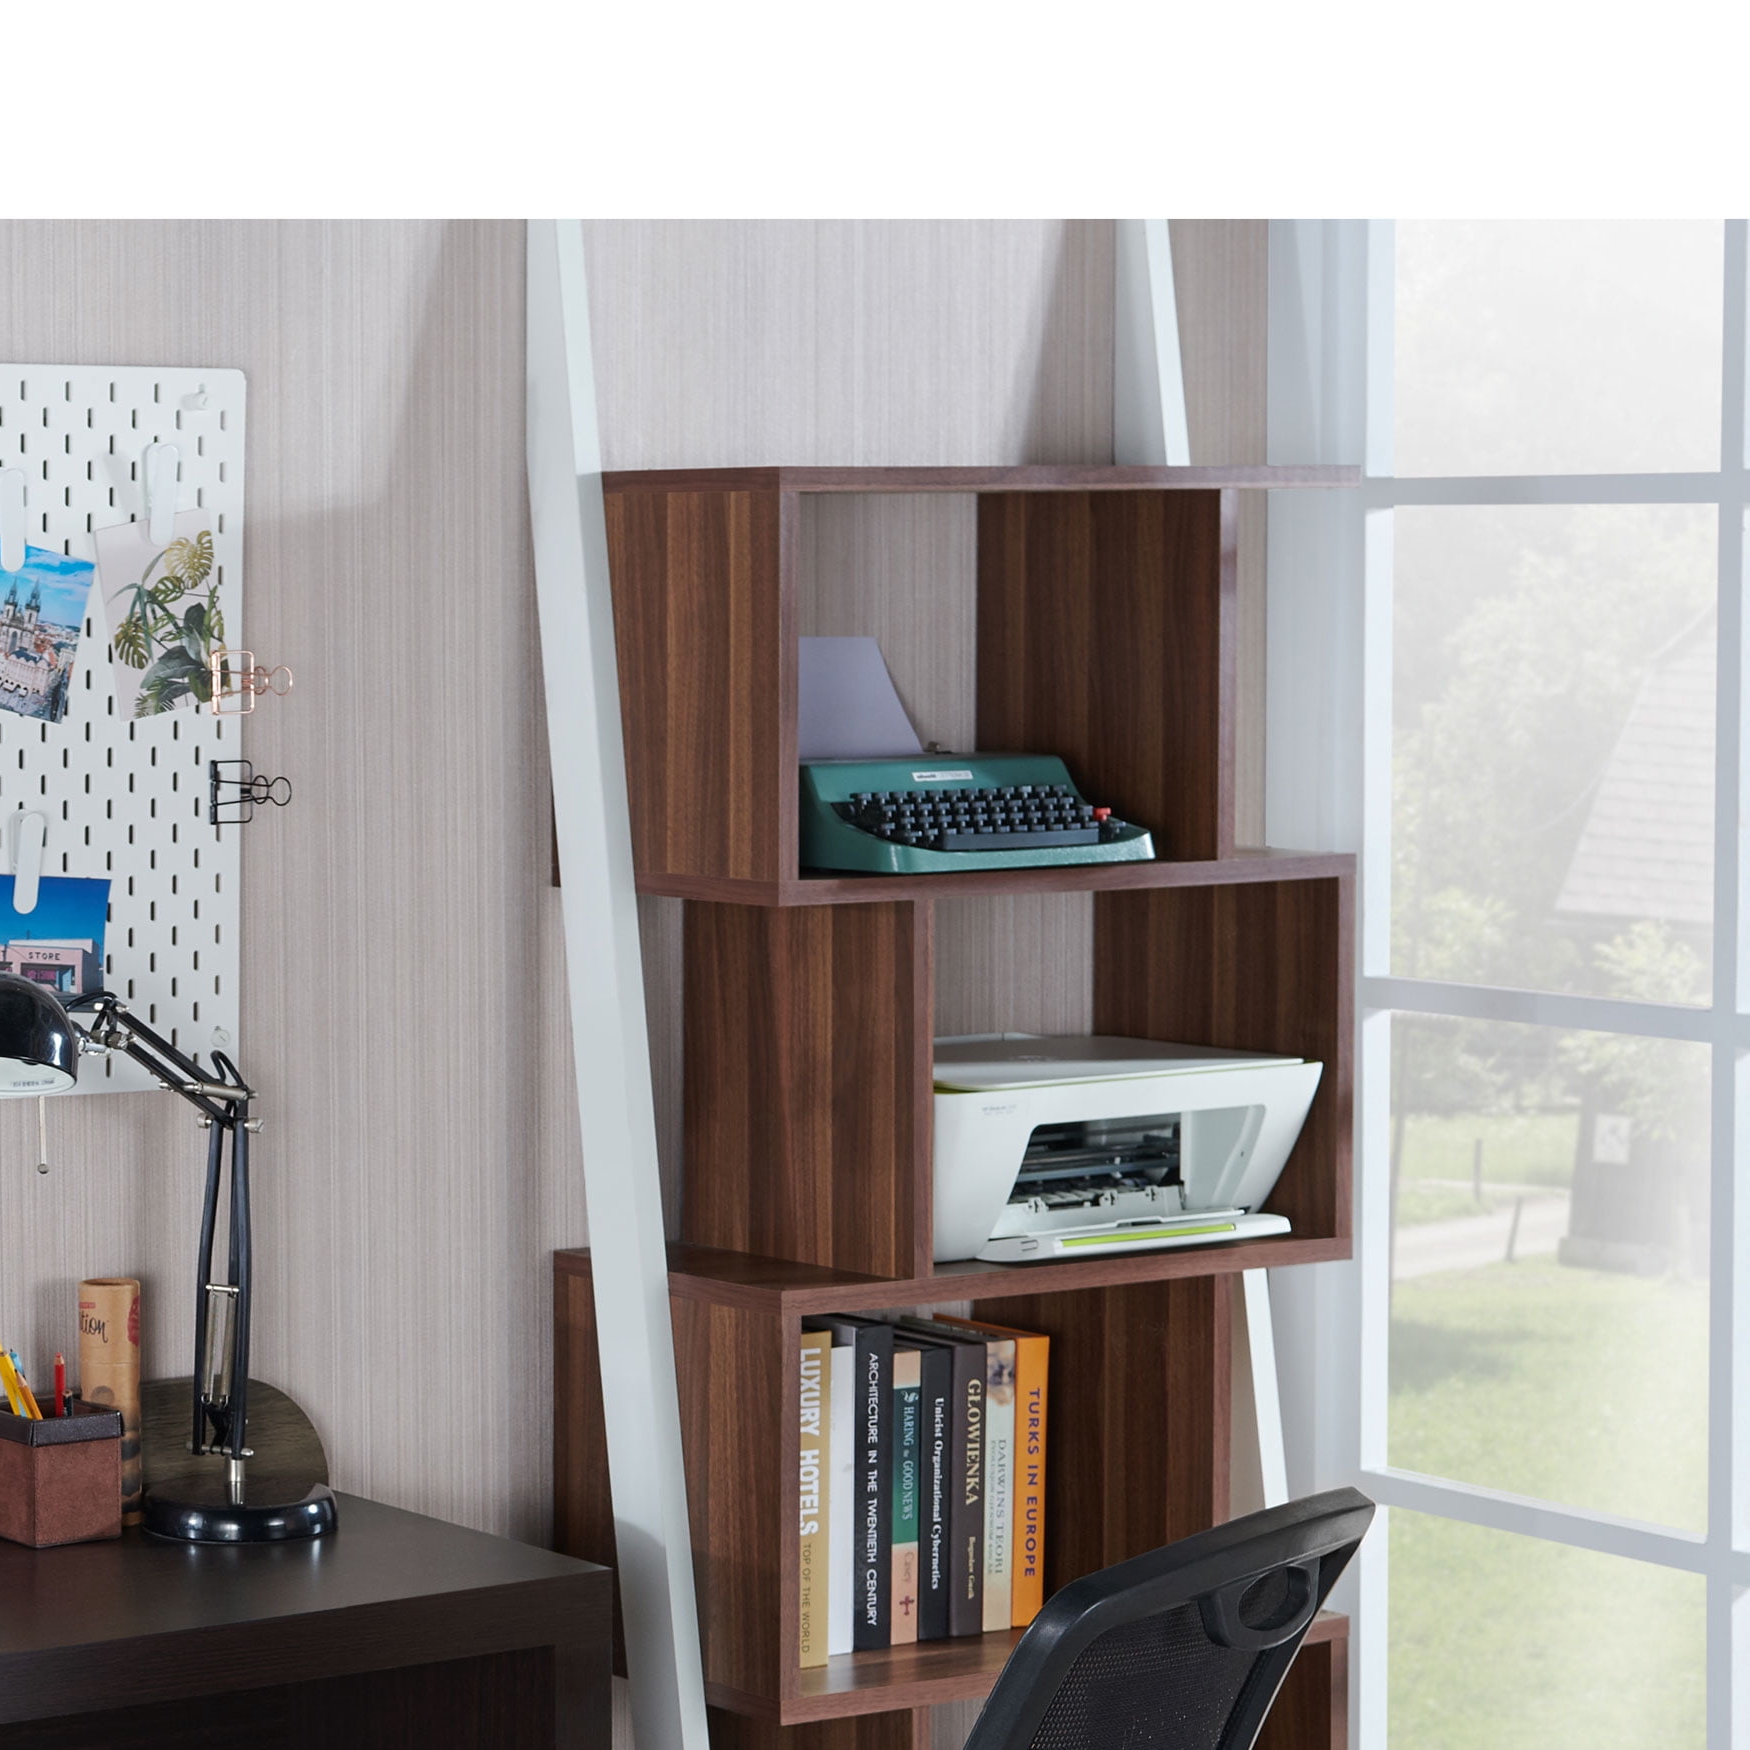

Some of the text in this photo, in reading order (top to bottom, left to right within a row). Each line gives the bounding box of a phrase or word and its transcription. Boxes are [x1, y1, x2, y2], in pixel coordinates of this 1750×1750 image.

[28, 951, 61, 961] STORE
[79, 1311, 108, 1343] tion
[800, 1347, 821, 1536] LUXURY HOTELS
[902, 1460, 914, 1490] GOOD
[932, 1440, 943, 1522] Organizational
[996, 1439, 1007, 1519] DARWINS
[866, 1352, 879, 1627] ARCHITECTURE IN THE TWENTIETH CENTURY
[901, 1491, 914, 1521] NEWS
[1024, 1387, 1040, 1577] TURKS IN EUROPE
[931, 1524, 942, 1590] Cybernetics
[801, 1543, 811, 1653] TOP OF THE WORLD
